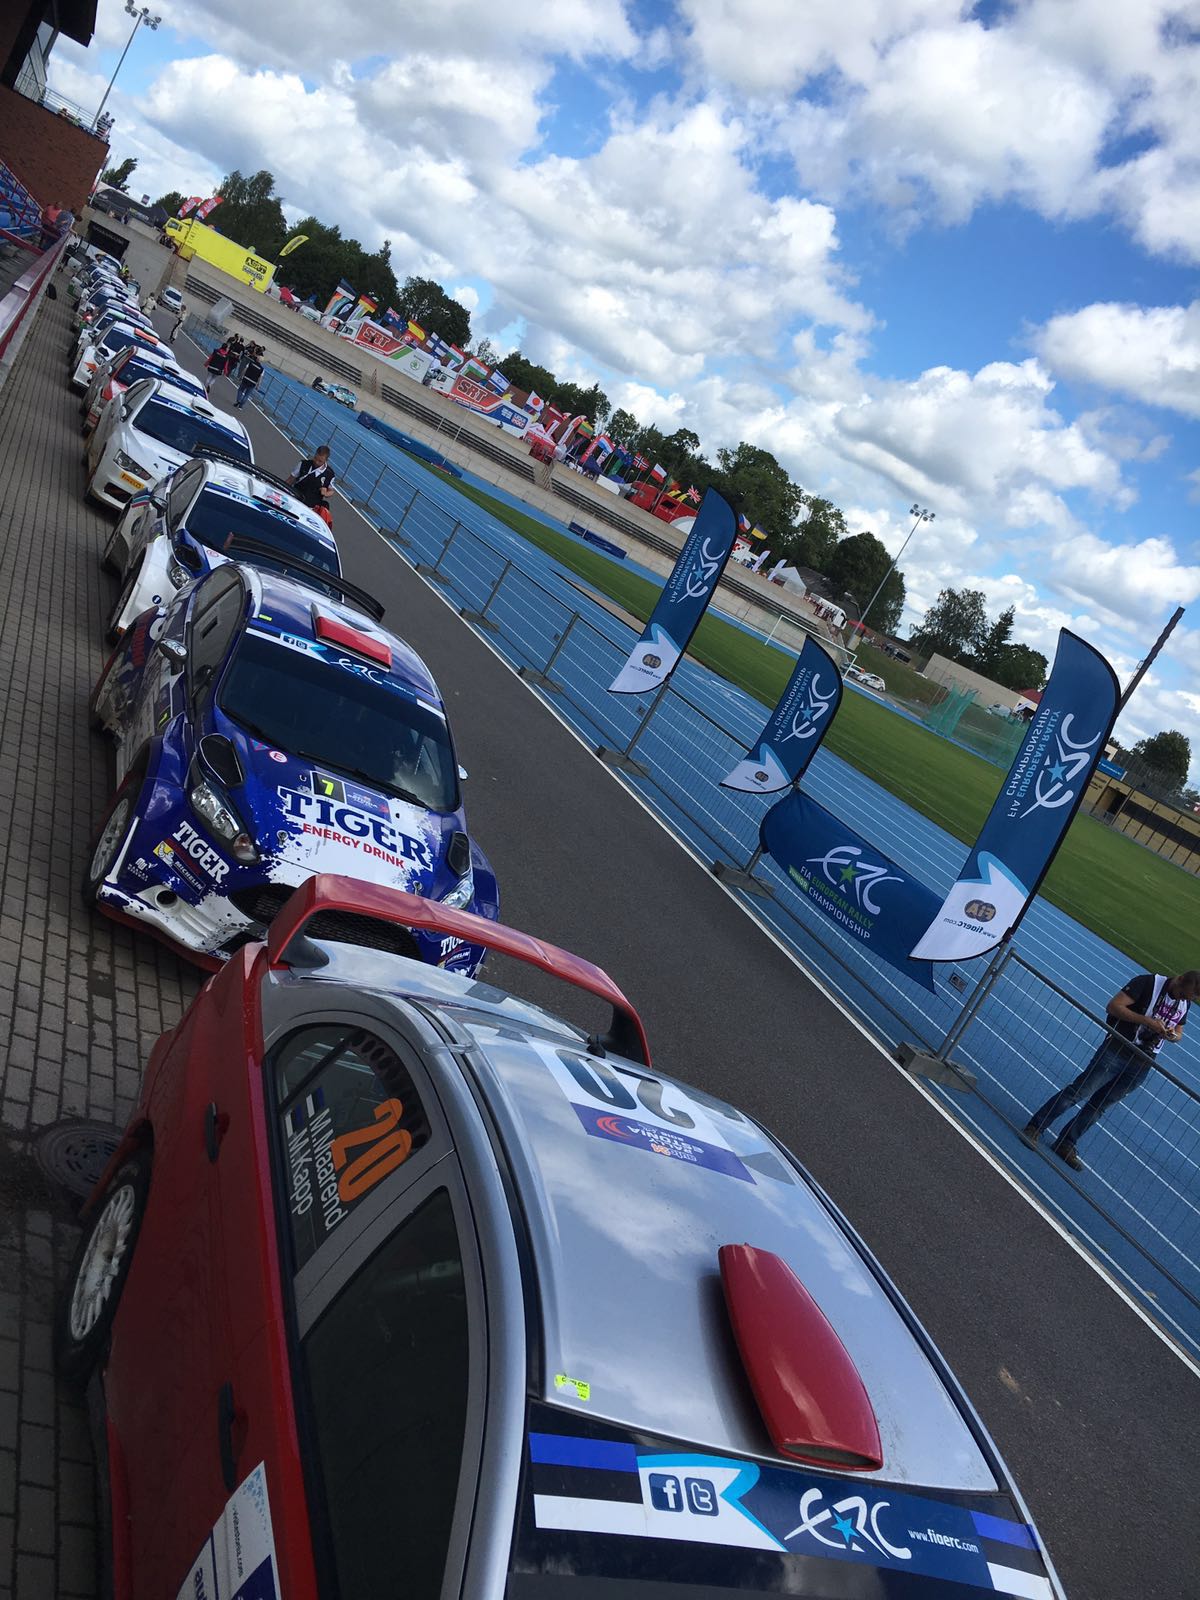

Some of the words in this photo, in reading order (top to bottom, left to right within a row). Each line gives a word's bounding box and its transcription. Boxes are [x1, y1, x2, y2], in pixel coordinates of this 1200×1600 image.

[457, 379, 488, 403] SRT
[330, 658, 383, 685] ERC
[321, 779, 334, 796] 7
[172, 820, 230, 884] TIGER
[278, 786, 433, 872] TIGER
[302, 822, 361, 849] ENERGY
[363, 843, 405, 869] DRINK
[174, 860, 204, 890] MICHELIN
[800, 865, 811, 881] FIA
[811, 876, 849, 910] EUROPEAN
[848, 907, 875, 930] RALLY
[808, 886, 871, 939] CHAMPIONSHIP
[288, 1126, 315, 1216] M.Kapp
[331, 1097, 413, 1202] 20
[783, 1487, 912, 1560] ERC
[907, 1527, 979, 1554] www.fiaerc.com
